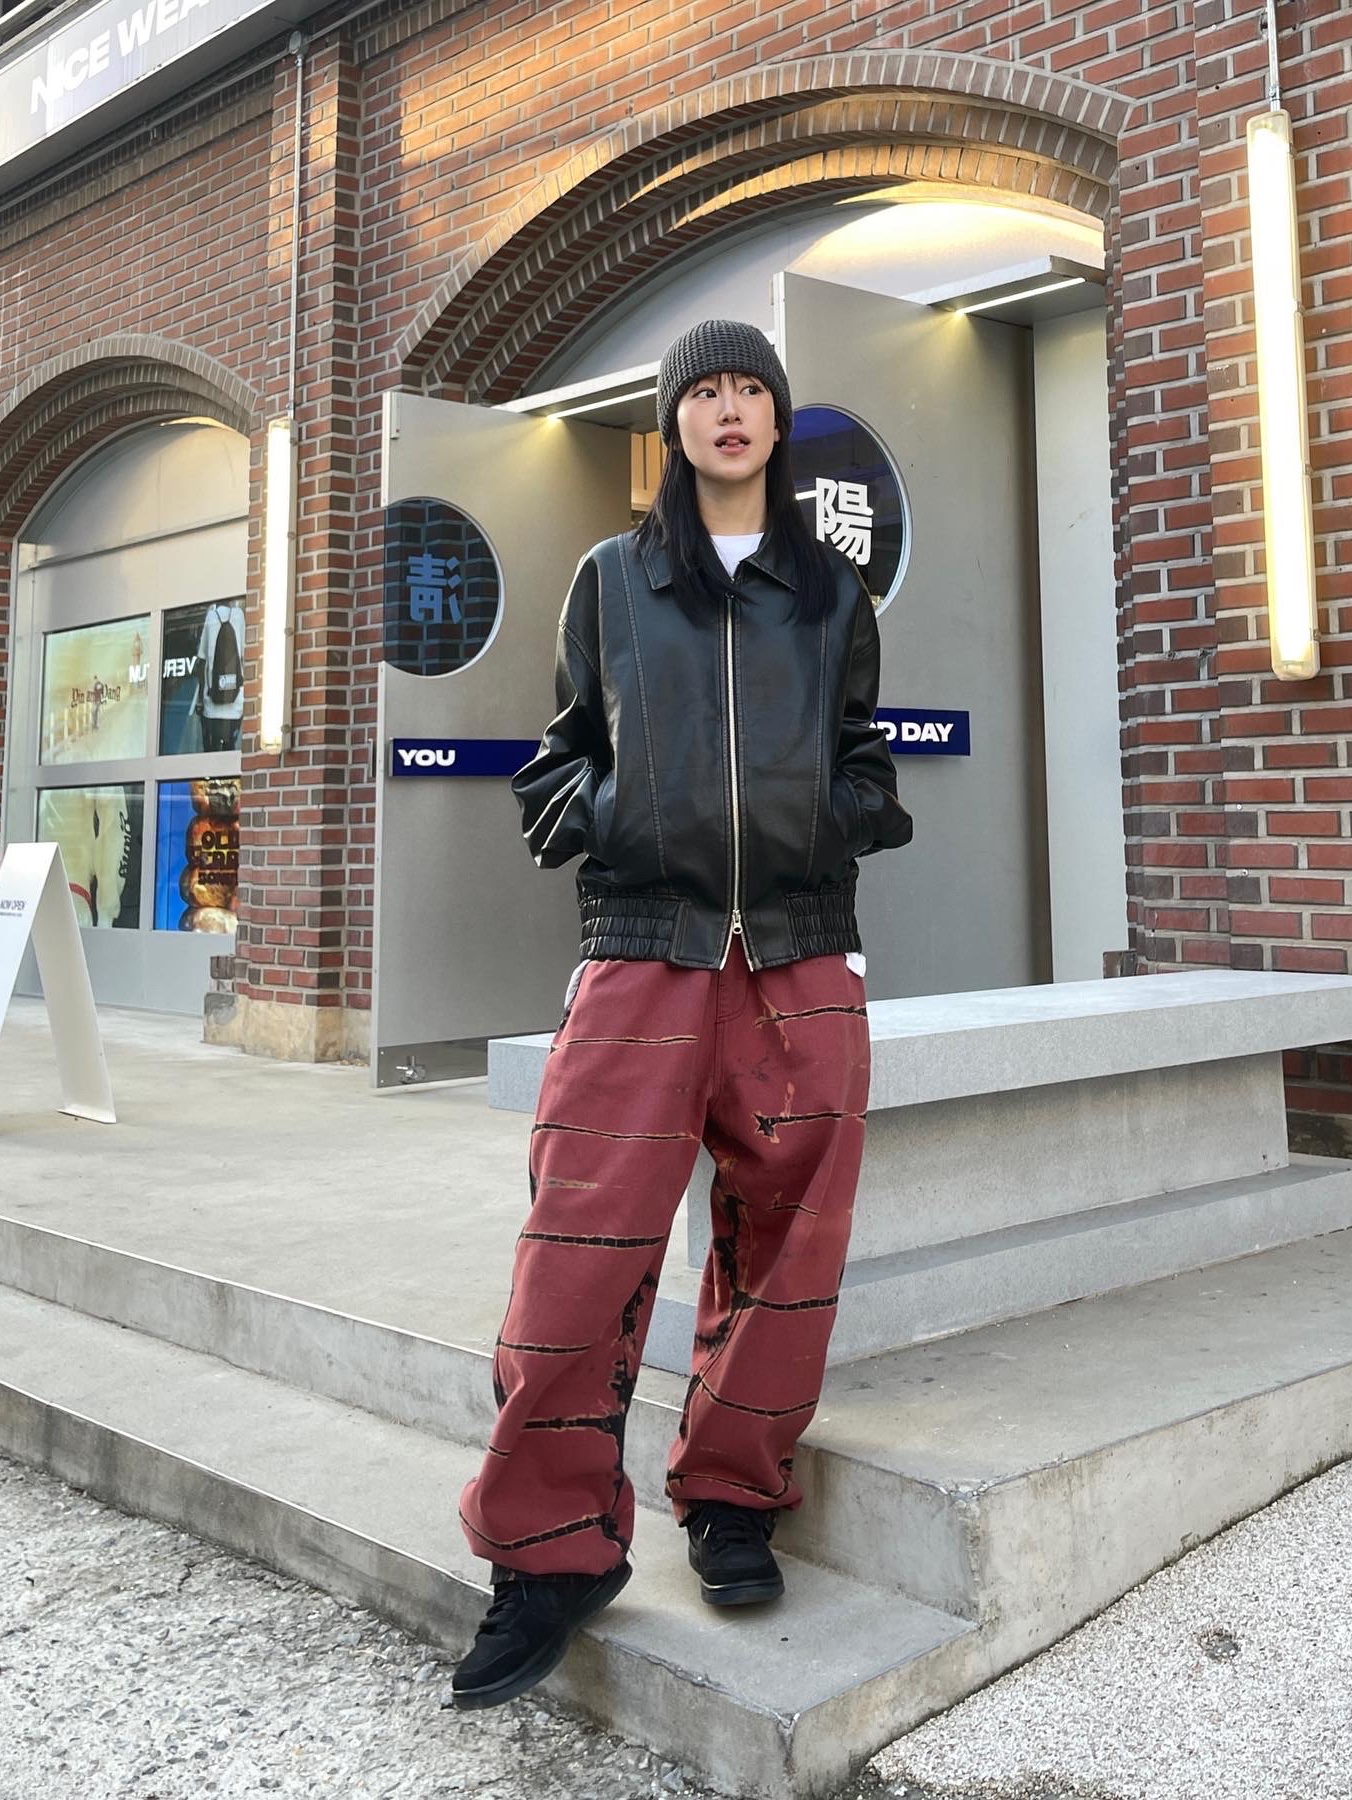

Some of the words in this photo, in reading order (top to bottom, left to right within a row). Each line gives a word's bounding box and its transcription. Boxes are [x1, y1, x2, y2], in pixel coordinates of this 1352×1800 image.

[30, 29, 111, 115] NICE
[815, 477, 874, 566] 陽
[397, 748, 456, 767] YOU
[901, 722, 954, 743] DAY
